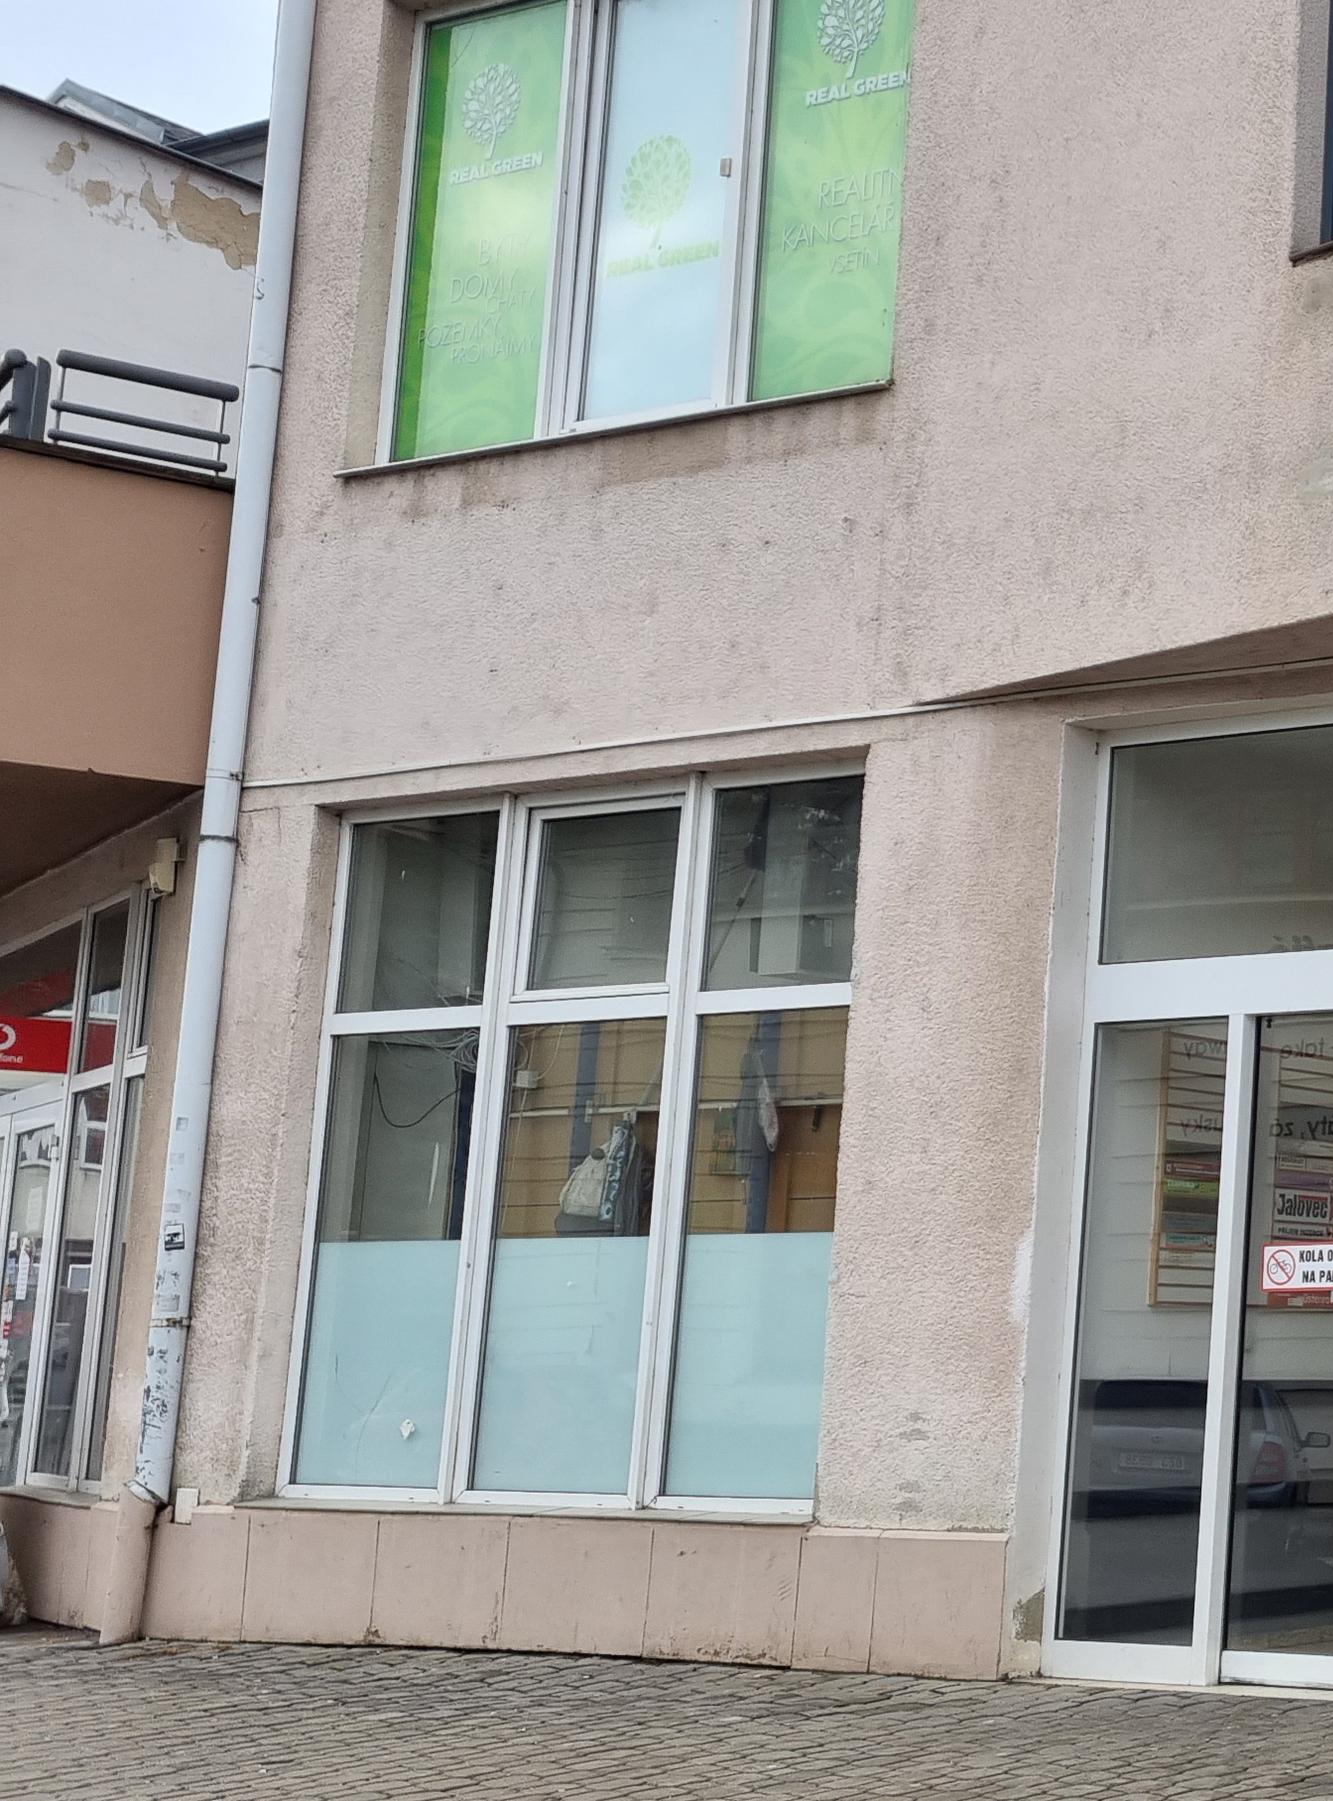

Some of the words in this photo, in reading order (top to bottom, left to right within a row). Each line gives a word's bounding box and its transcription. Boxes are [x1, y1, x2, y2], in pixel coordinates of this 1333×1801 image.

[806, 84, 851, 108] REAL
[854, 68, 910, 97] GREEN
[450, 166, 489, 186] REAL
[491, 151, 543, 178] GREEN
[606, 254, 653, 277] REAL
[658, 240, 719, 269] GREEN
[450, 267, 519, 304] DOMY
[417, 317, 502, 350] POZEMKY
[1277, 1194, 1328, 1218] Jalovec
[1299, 1249, 1324, 1263] KOLA
[1302, 1270, 1316, 1283] NA
